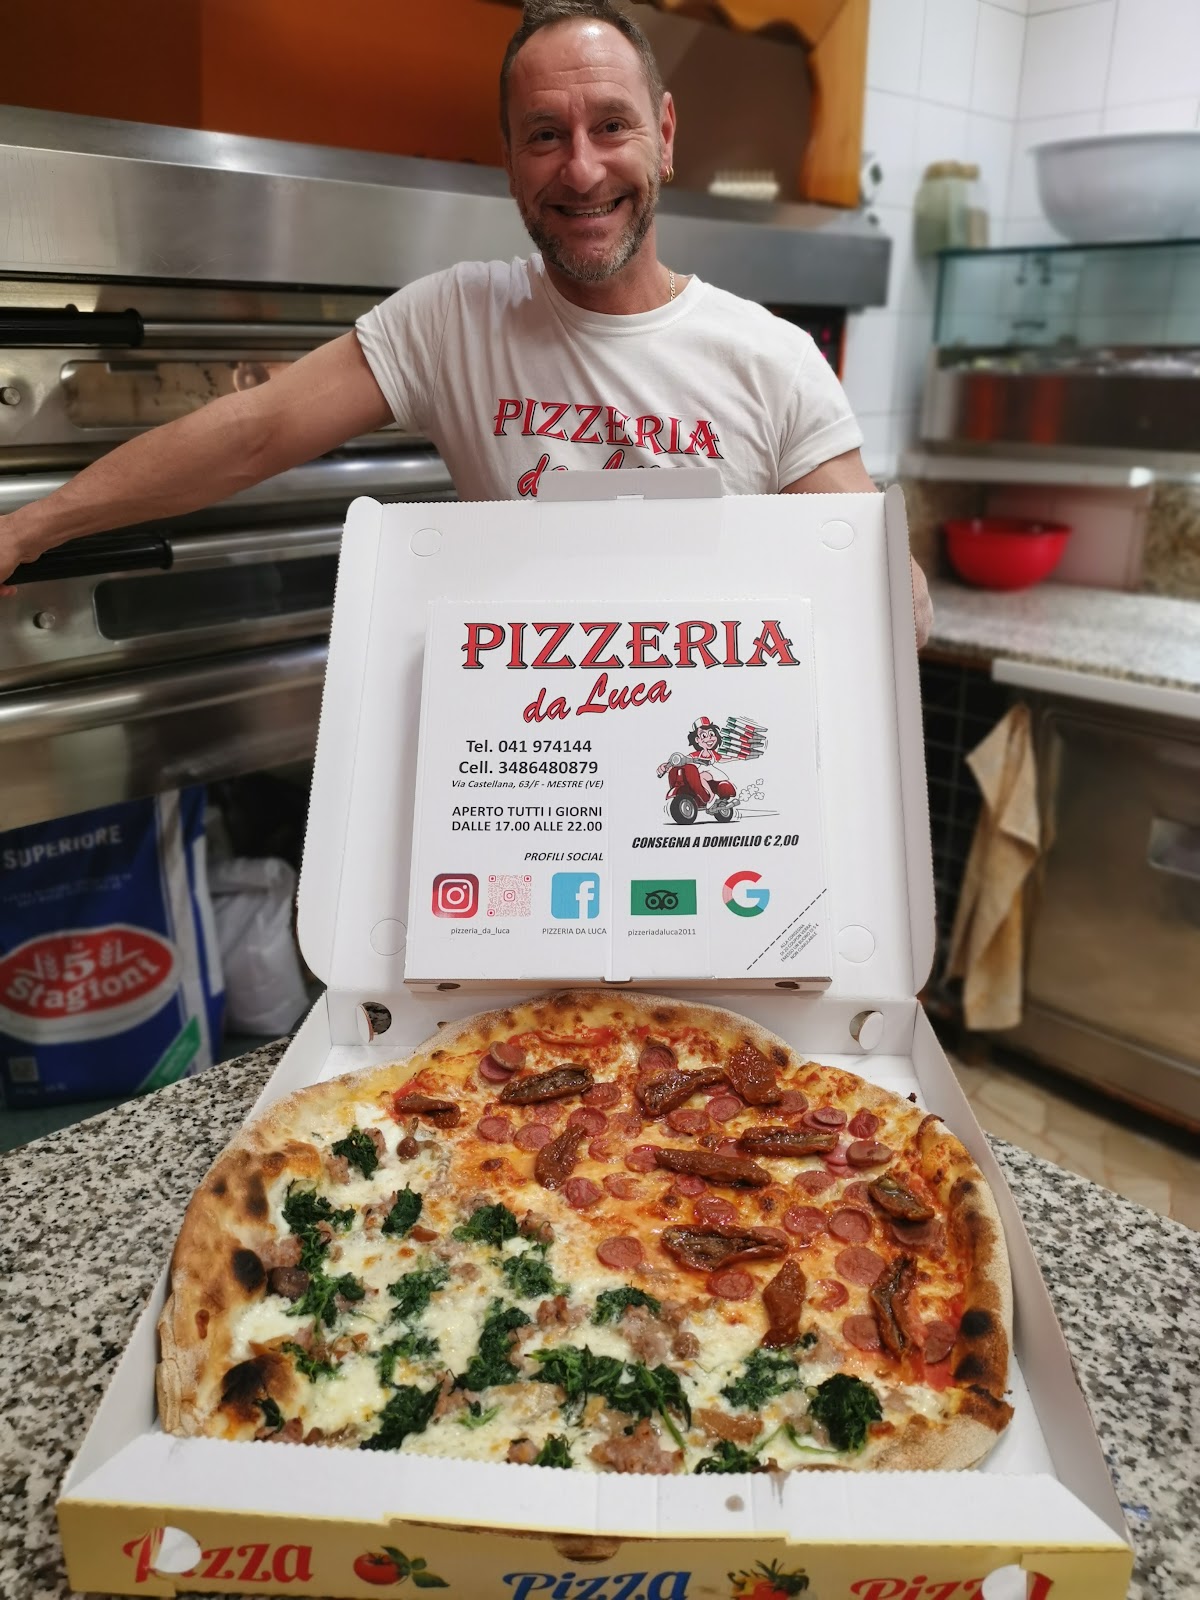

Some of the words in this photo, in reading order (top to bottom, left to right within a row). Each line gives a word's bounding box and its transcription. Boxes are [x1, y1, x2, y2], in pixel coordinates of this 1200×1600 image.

[493, 398, 724, 459] PIZZERIA
[461, 620, 801, 669] PIZZERIA
[523, 688, 571, 723] da
[576, 672, 672, 716] Luca
[466, 740, 493, 752] Tel.
[499, 740, 527, 752] 041
[533, 740, 592, 752] 974144
[459, 761, 492, 773] Cell.
[499, 761, 598, 774] 3486480879
[468, 780, 515, 789] Castellana,
[519, 780, 540, 789] 63/F
[585, 780, 603, 789] (VE)
[452, 807, 503, 816] APERTO
[507, 807, 543, 816] TUTTI
[548, 806, 552, 817] I
[556, 807, 601, 816] GIORNI
[452, 821, 491, 831] DALLE
[496, 821, 530, 831] 17.00
[534, 822, 563, 831] ALLE
[568, 821, 602, 831] 22.00
[4, 825, 122, 869] SUPERIORE
[632, 837, 691, 848] CONSEGNA
[691, 836, 701, 848] A
[702, 835, 762, 847] DOMICILIO
[764, 835, 772, 846] €
[773, 835, 799, 847] 2,00
[524, 853, 564, 861] PROFILI
[566, 853, 603, 861] SOCIAL
[450, 927, 510, 936] pizzeria_da_luca
[542, 927, 574, 935] PIZZERIA
[576, 927, 586, 935] DA
[588, 927, 607, 935] LUCA
[627, 928, 696, 937] pizzeriadaluca2011
[64, 949, 94, 982] 5
[5, 955, 161, 1012] Stagioni
[122, 1527, 314, 1583] Pzza
[502, 1571, 692, 1600] Pizza
[850, 1575, 1054, 1600] Piz
